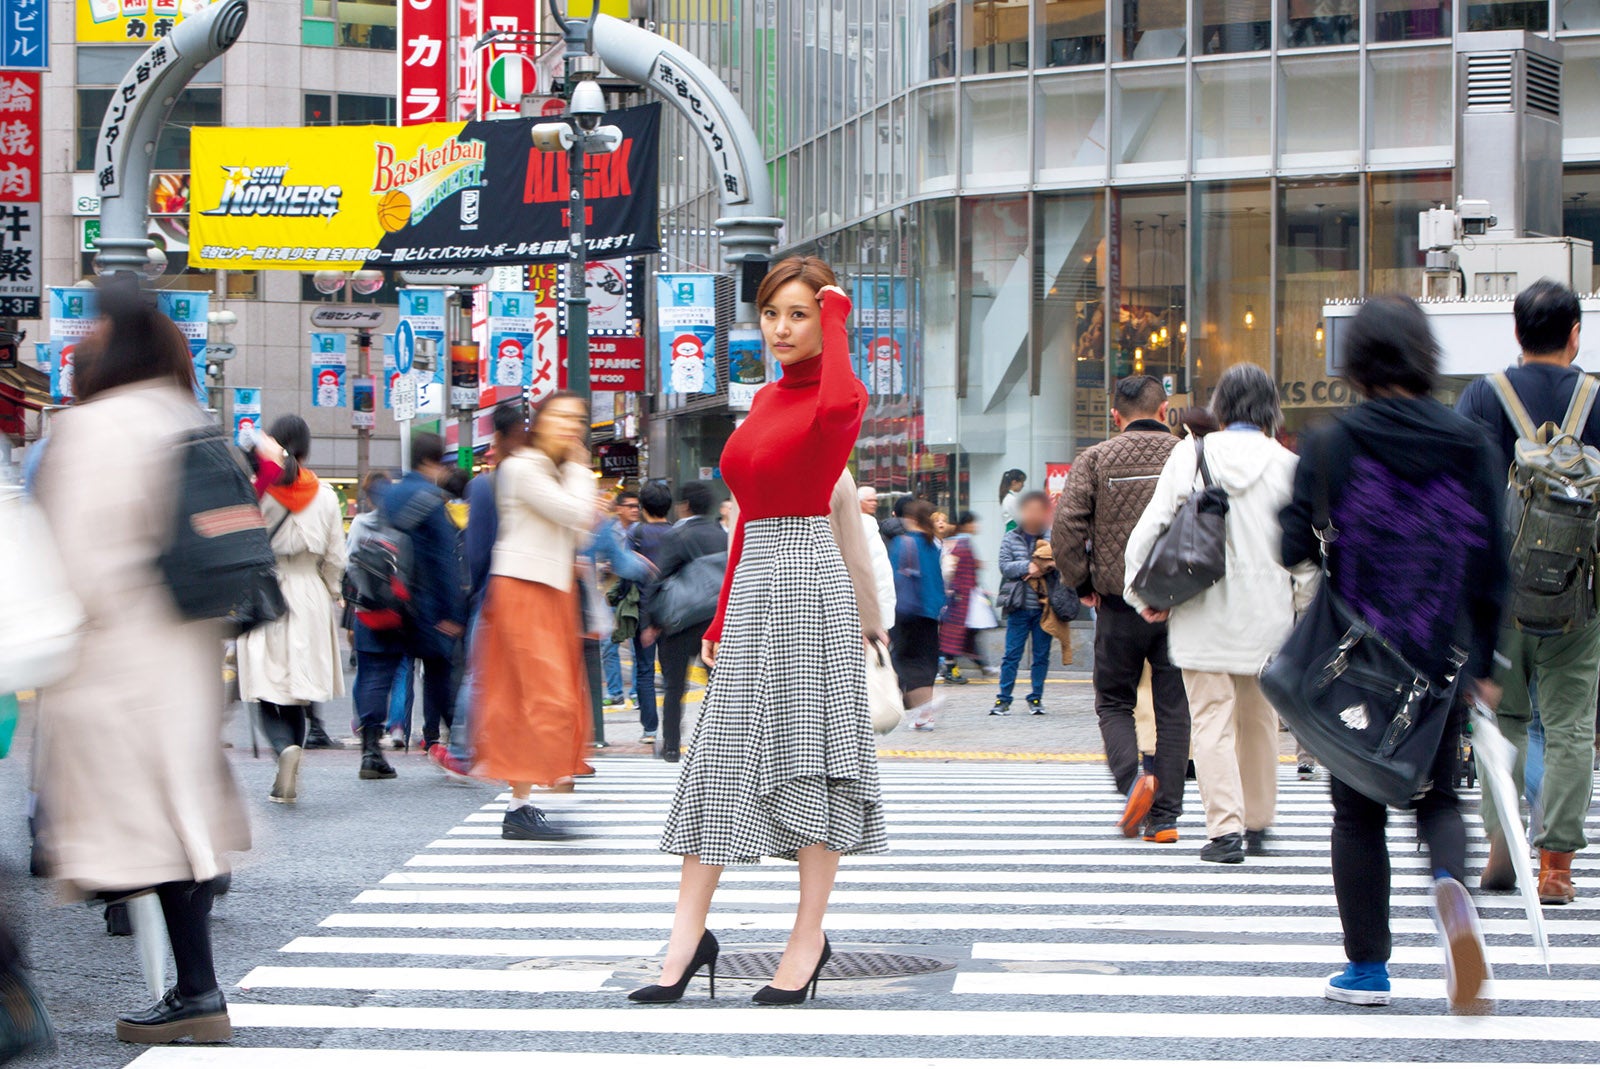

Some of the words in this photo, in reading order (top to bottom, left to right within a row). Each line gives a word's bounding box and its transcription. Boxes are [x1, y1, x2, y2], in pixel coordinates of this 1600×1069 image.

[405, 0, 442, 120] カラ
[99, 46, 167, 191] 渋谷センター街
[660, 64, 738, 195] 渋谷センター街
[198, 165, 342, 218] ROCKERS
[251, 166, 285, 185] SUN
[373, 138, 484, 193] Basketball
[79, 197, 99, 211] 3F
[411, 163, 482, 226] STREET
[588, 343, 617, 353] CLUB
[595, 358, 641, 369] PANIC
